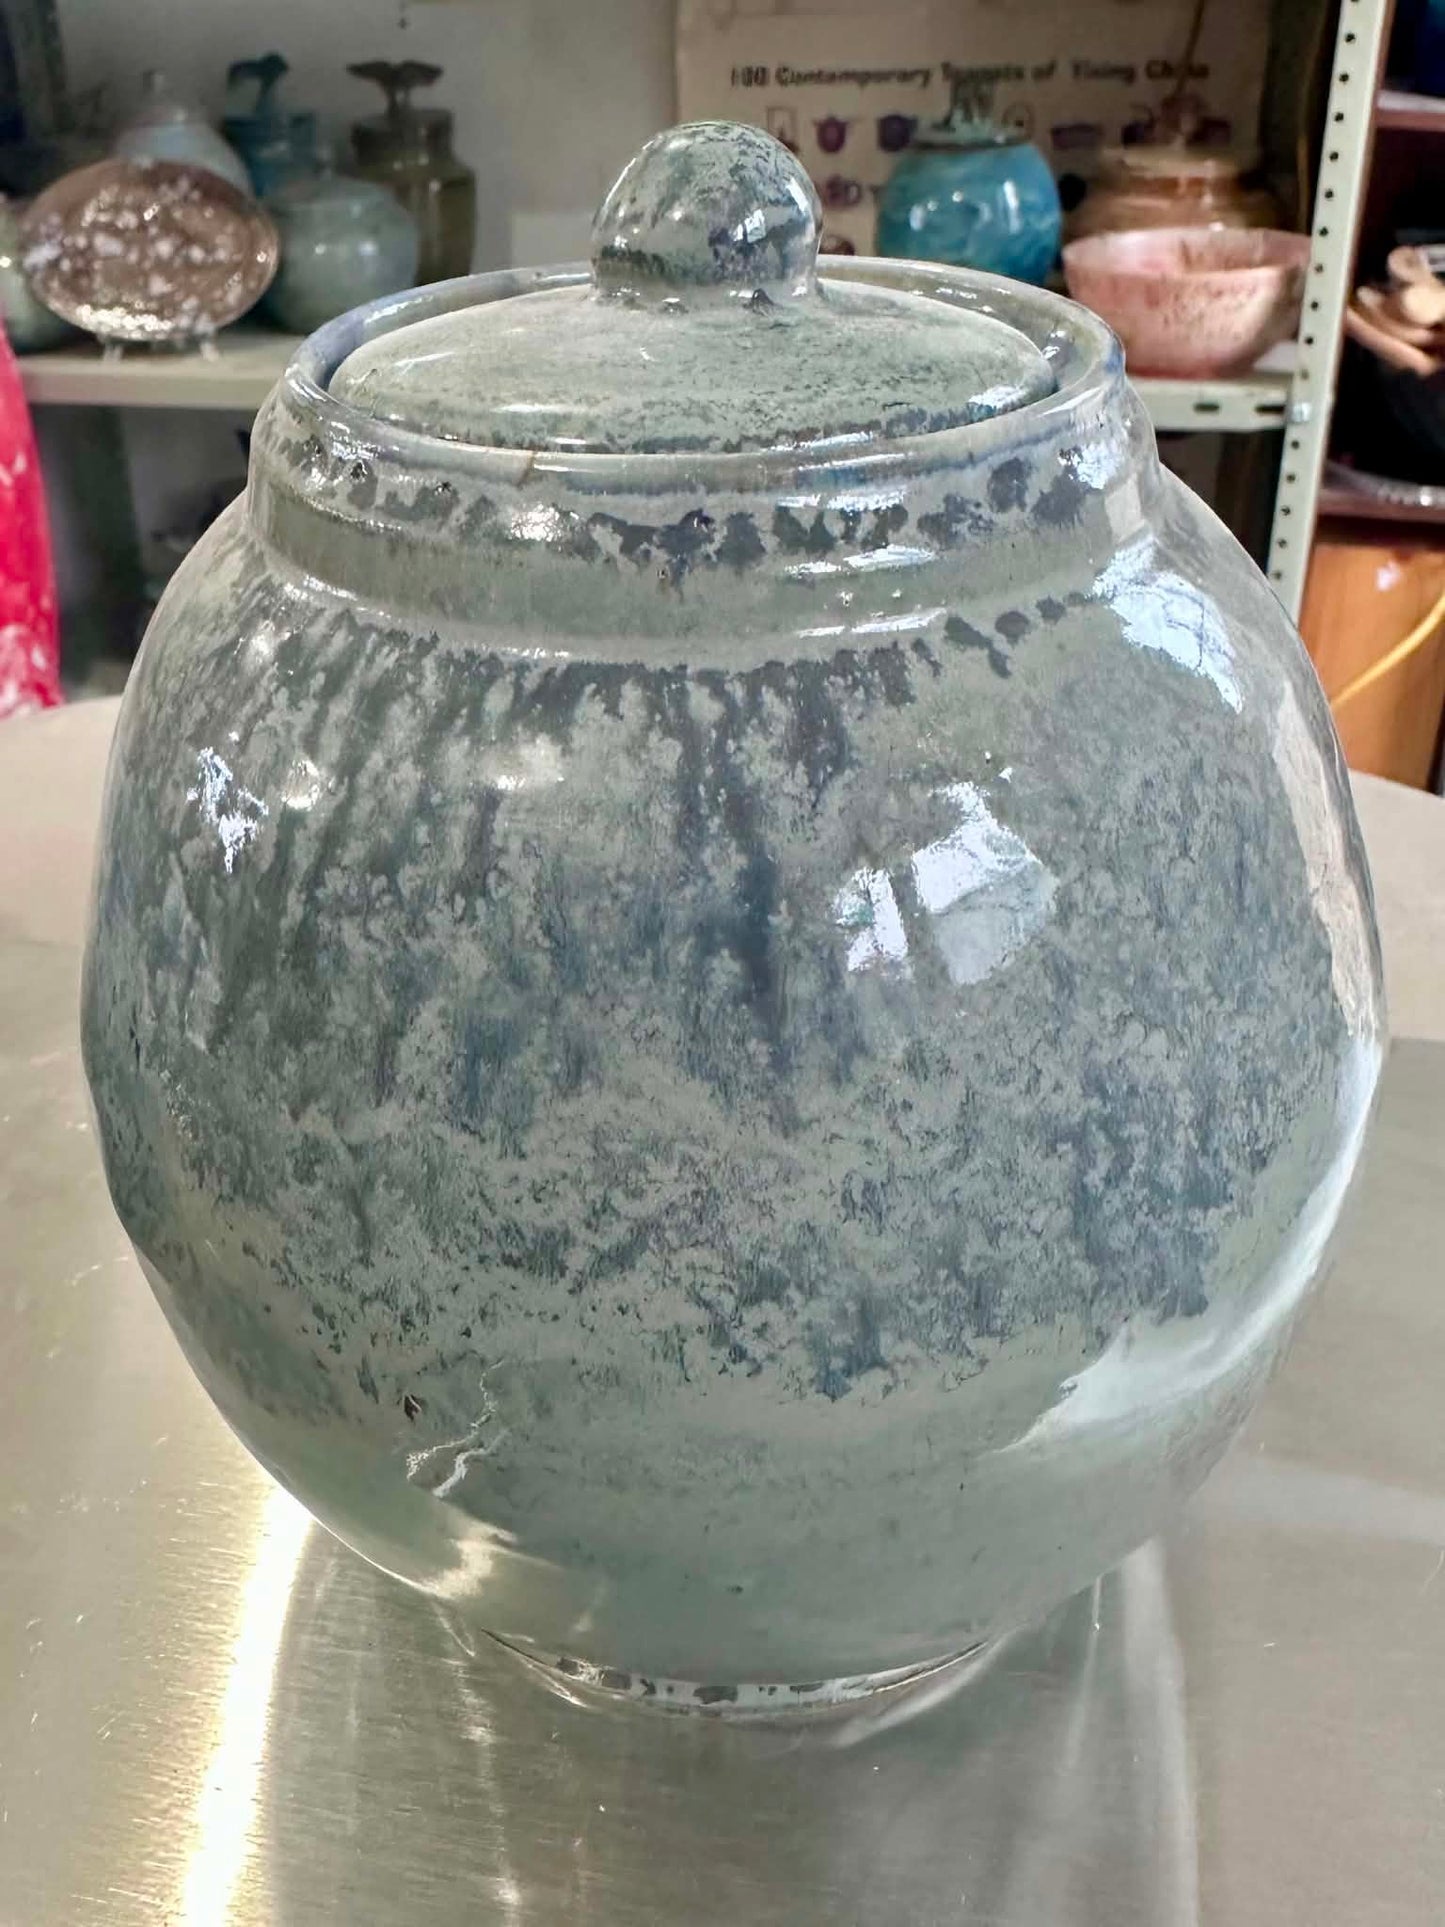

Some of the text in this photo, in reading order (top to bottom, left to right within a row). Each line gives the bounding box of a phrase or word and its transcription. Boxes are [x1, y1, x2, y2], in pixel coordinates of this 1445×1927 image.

[730, 66, 770, 88] 100
[775, 65, 932, 90] Contemporary
[1032, 59, 1057, 81] of
[1144, 60, 1210, 80] Chna
